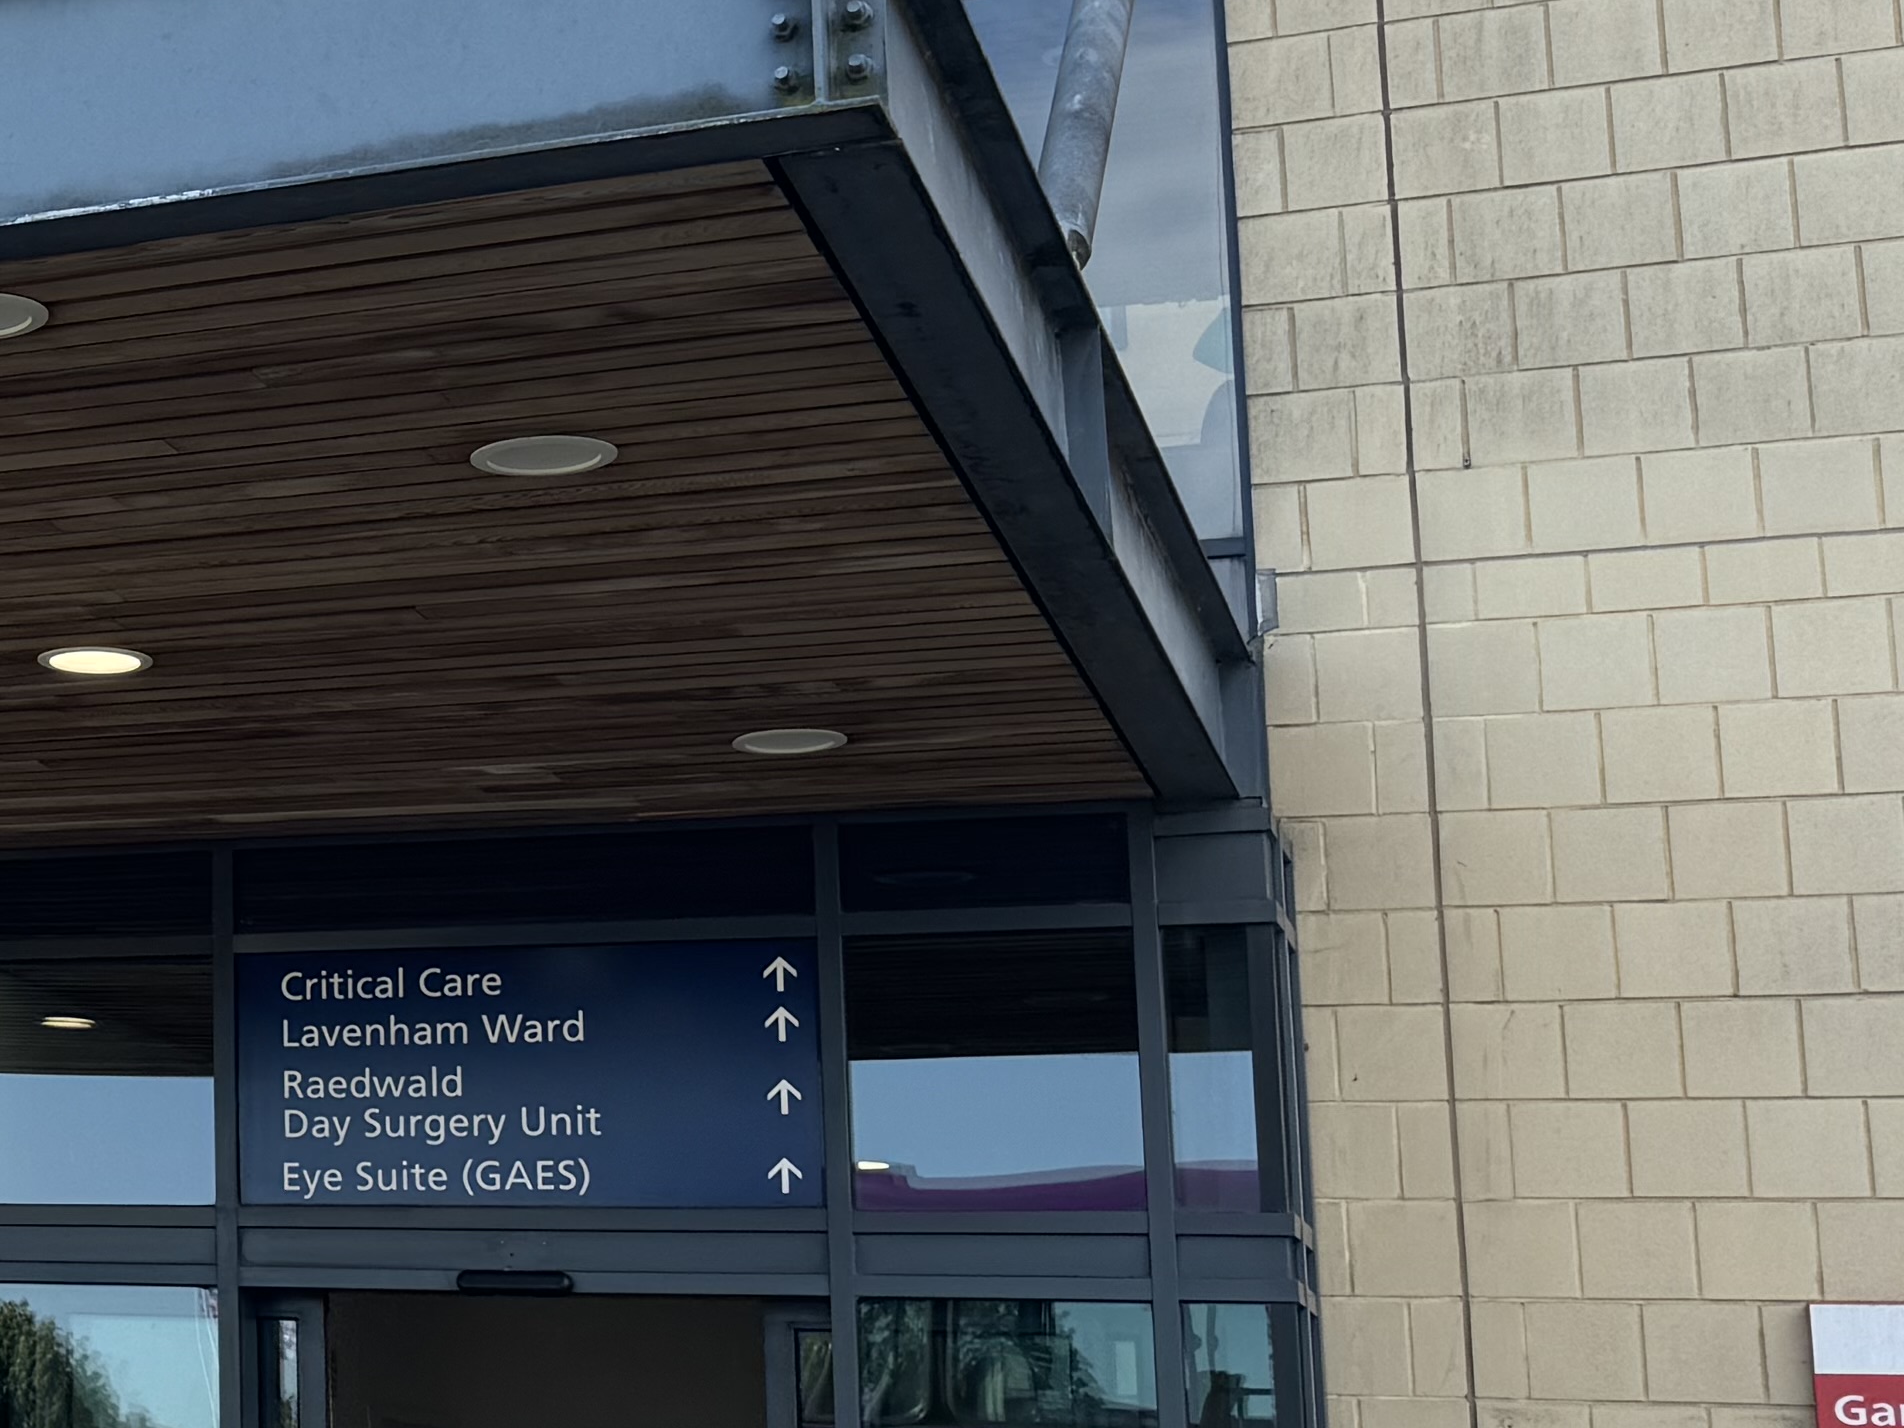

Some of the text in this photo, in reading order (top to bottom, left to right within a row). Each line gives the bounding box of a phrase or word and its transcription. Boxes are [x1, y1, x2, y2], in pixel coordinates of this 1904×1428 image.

[281, 968, 502, 1001] Critical Care
[282, 1010, 586, 1048] Lavenham Ward
[283, 1066, 463, 1099] Raedwald
[284, 1106, 602, 1146] Day Surgery Unit
[282, 1158, 591, 1200] Eye Suite (GAES)
